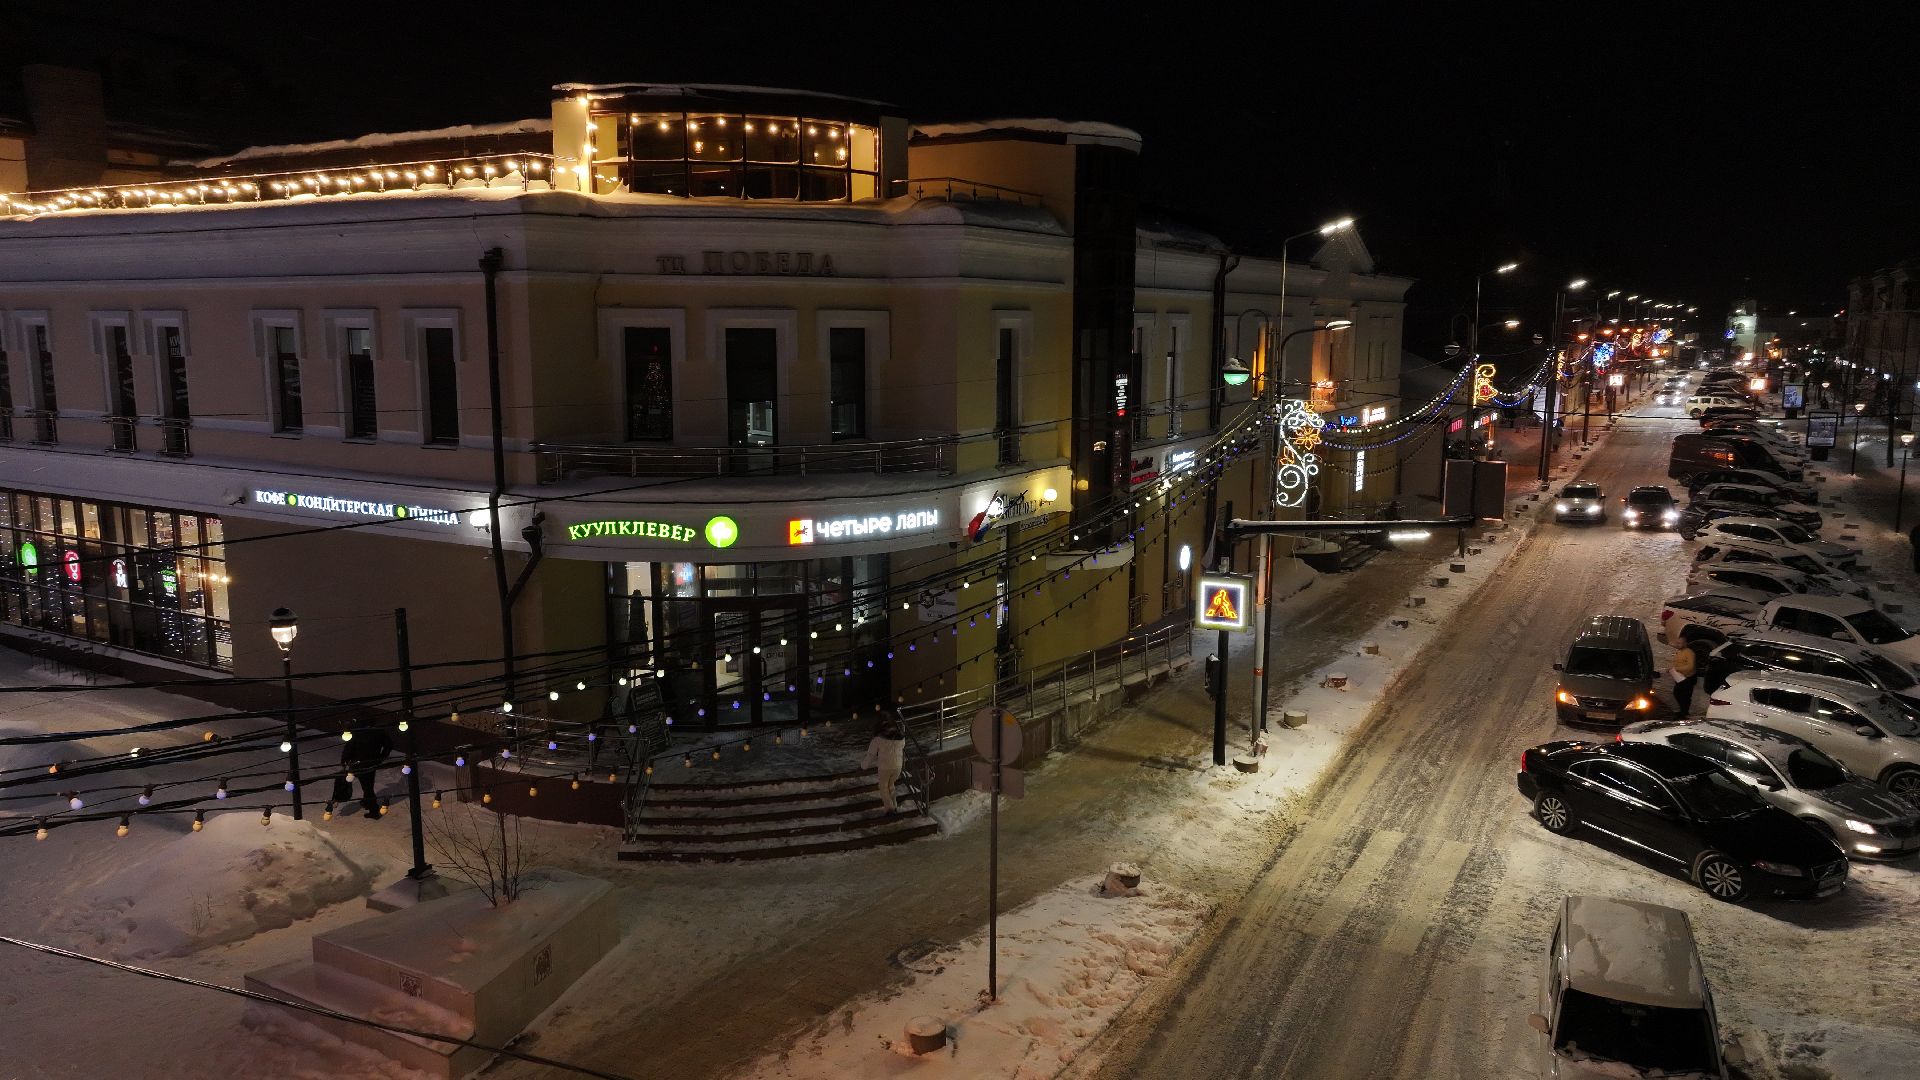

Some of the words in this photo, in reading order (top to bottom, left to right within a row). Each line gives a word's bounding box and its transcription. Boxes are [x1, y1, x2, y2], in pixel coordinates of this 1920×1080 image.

[702, 251, 836, 276] ПОБЕДА
[256, 491, 286, 505] КОФЕ
[297, 494, 394, 517] КОНДИТЕРСКАЯ
[408, 506, 460, 525] ПИЦЦА
